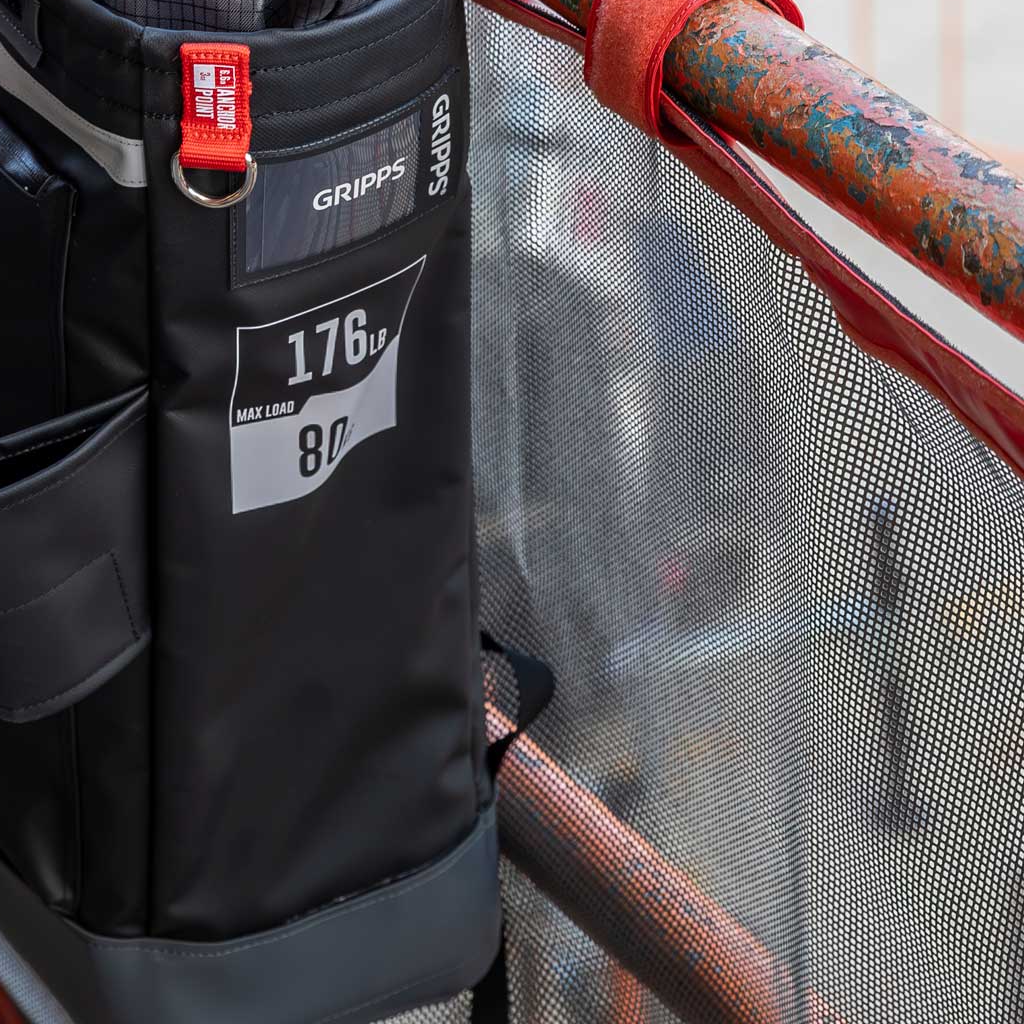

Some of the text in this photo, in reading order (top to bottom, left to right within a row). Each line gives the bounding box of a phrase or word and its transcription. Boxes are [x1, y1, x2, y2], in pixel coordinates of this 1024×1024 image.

[195, 88, 215, 119] POINT
[217, 88, 236, 130] ANCHOR
[312, 157, 406, 211] GRIPPS
[287, 308, 388, 386] 176LB
[236, 400, 295, 423] MAX LOAD
